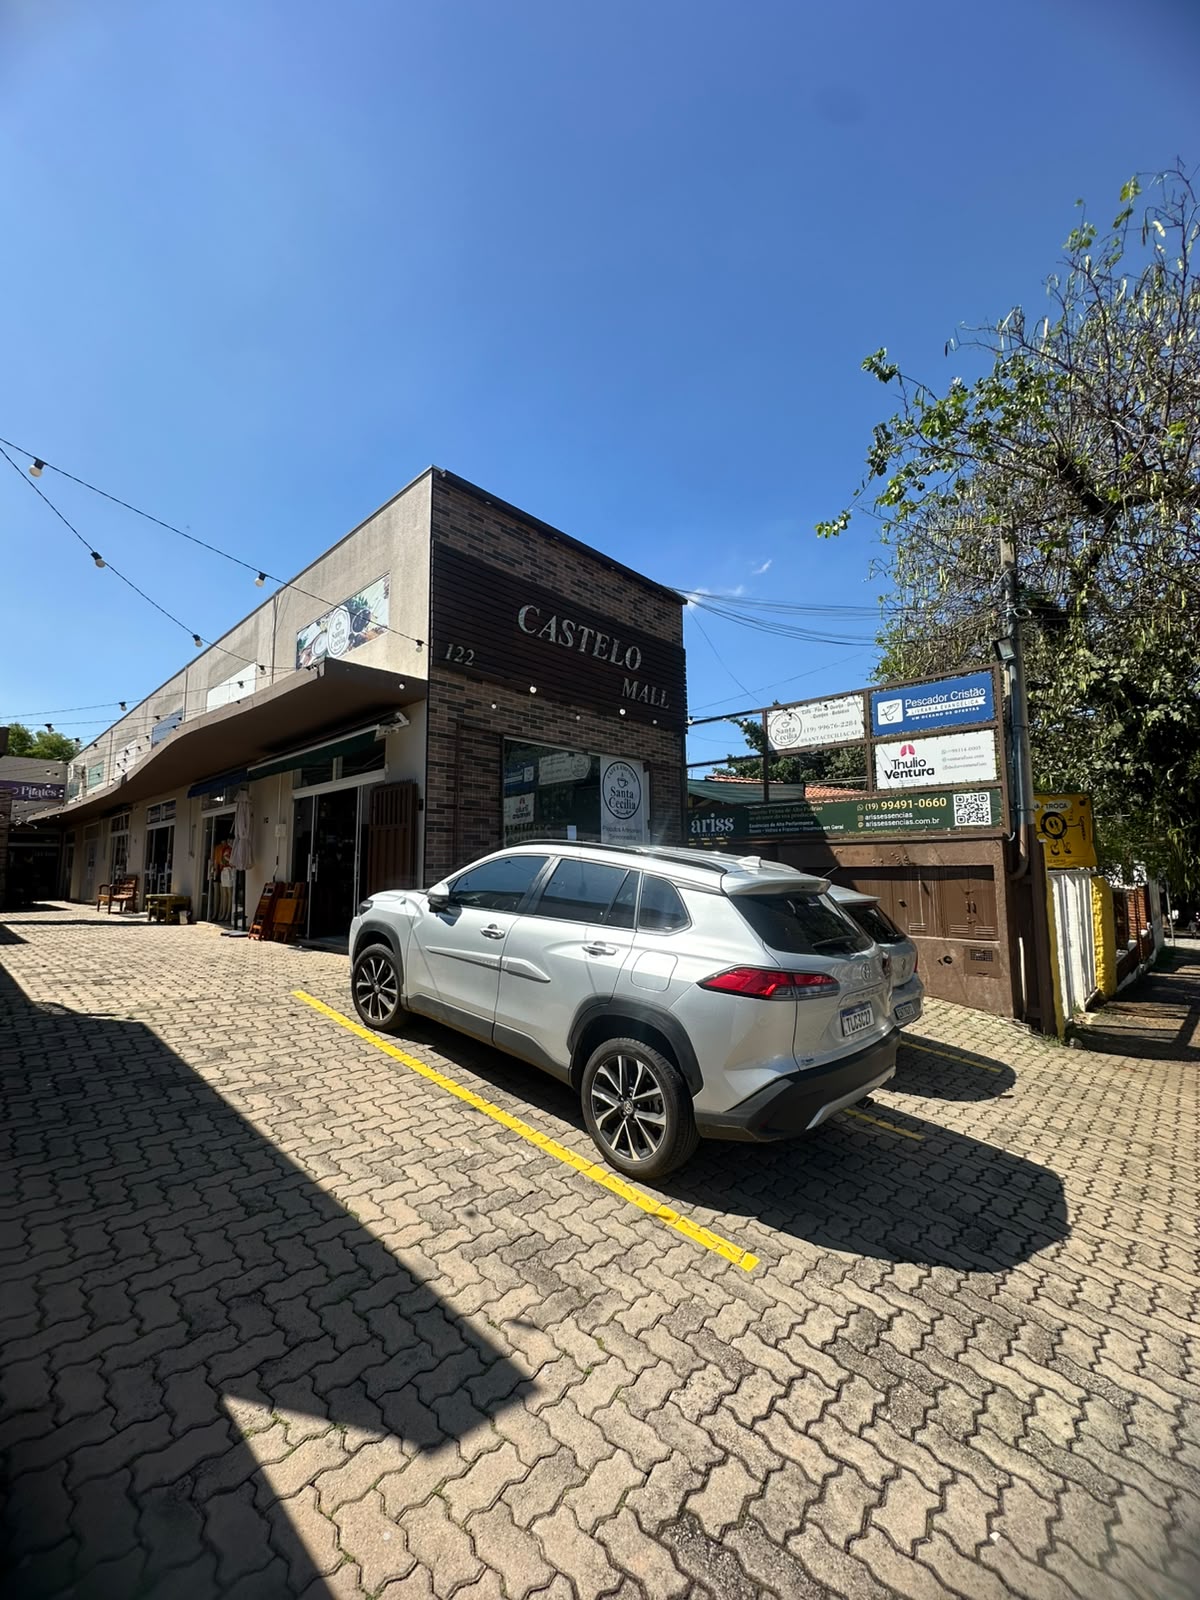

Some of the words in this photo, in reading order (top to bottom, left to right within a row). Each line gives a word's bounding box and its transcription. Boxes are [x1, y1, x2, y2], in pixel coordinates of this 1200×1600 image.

[518, 604, 642, 671] CASTELO
[445, 643, 475, 666] 122
[622, 677, 670, 709] MALL
[905, 694, 948, 708] Pescador
[950, 688, 986, 700] Cristão
[911, 706, 938, 715] LIVRARIA
[776, 727, 796, 735] Santa
[884, 767, 935, 780] Ventura
[21, 785, 57, 798] Pilates
[610, 786, 634, 799] Santa
[865, 802, 879, 811] (19)
[881, 797, 947, 811] 99491-0660
[865, 812, 913, 821] arissessencias
[865, 817, 940, 828] arissessencias.com.br
